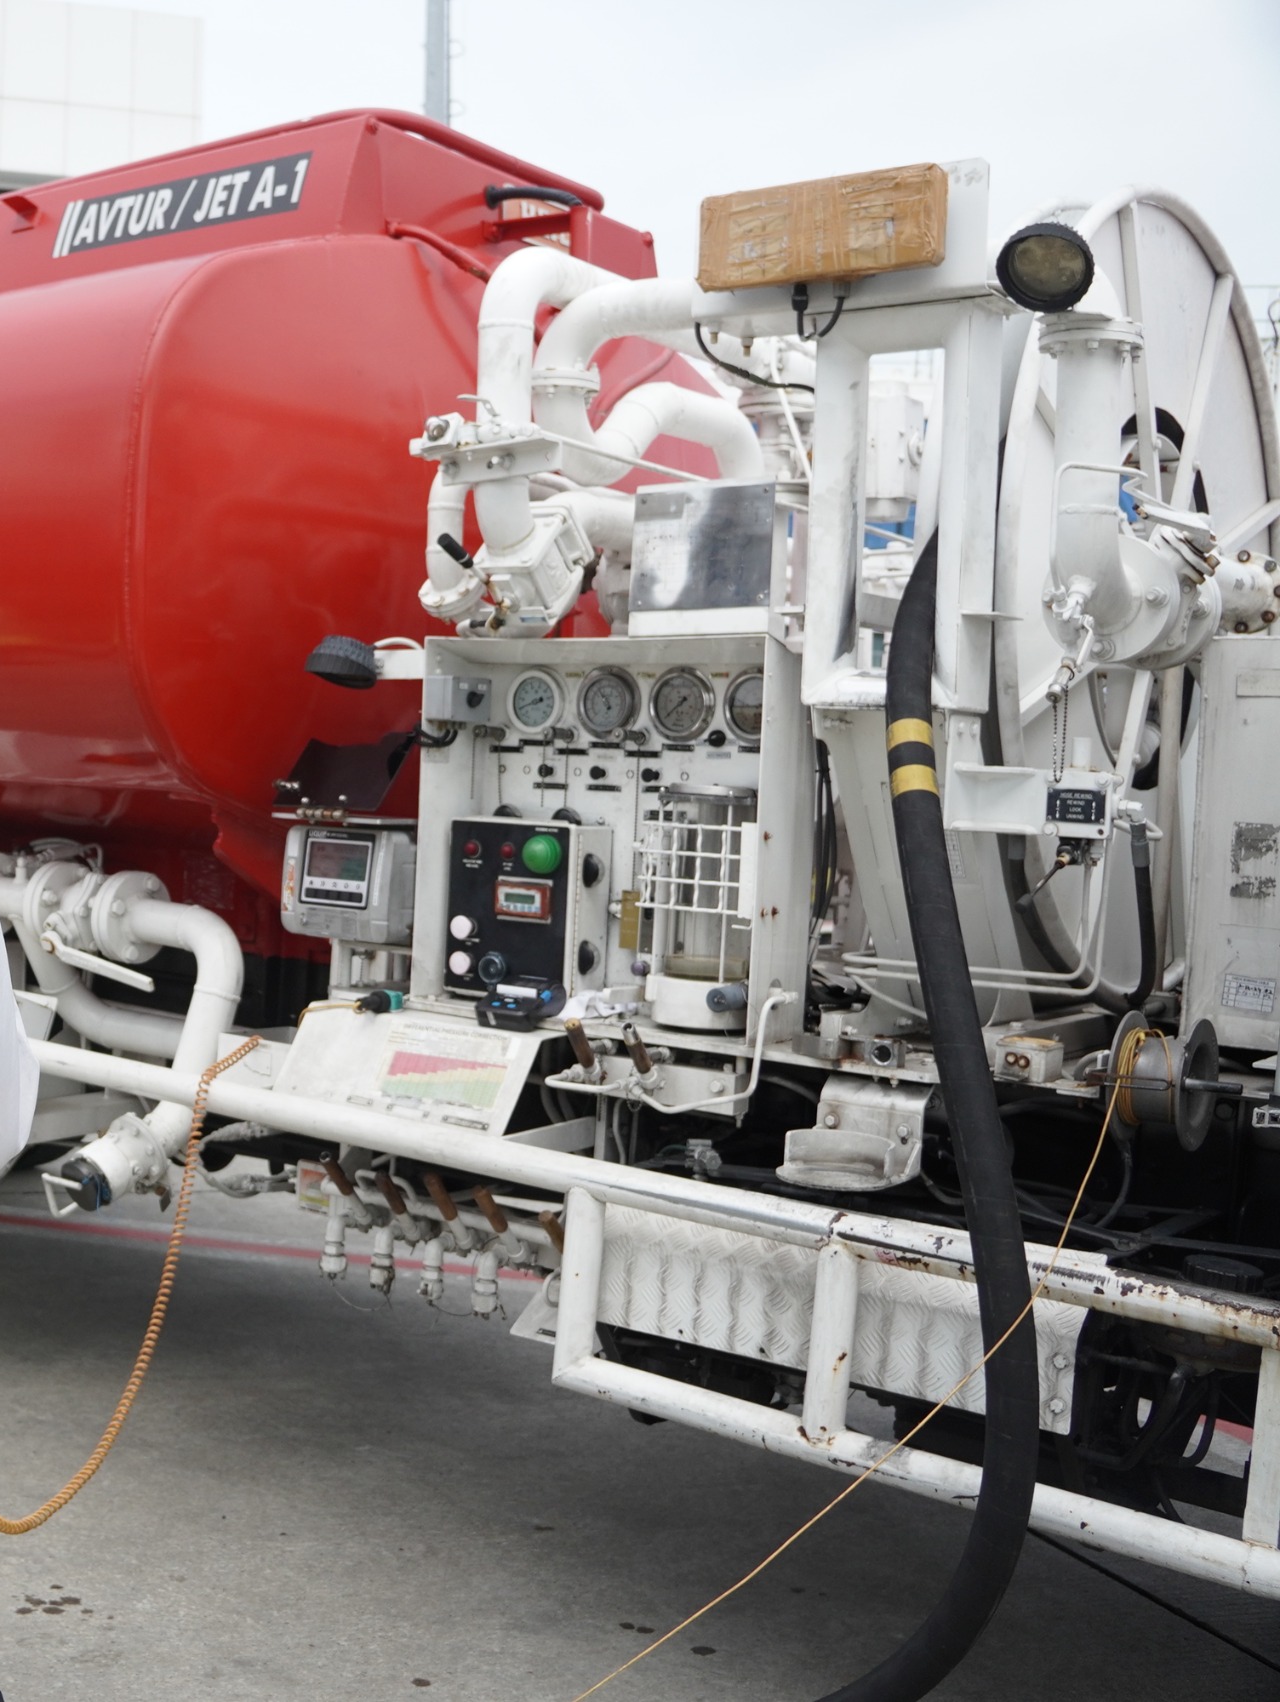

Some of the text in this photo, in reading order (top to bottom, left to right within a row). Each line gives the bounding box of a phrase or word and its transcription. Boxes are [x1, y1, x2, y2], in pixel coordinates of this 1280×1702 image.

[72, 188, 173, 247] AVTUR
[193, 169, 251, 223] JET
[248, 159, 309, 212] A-1
